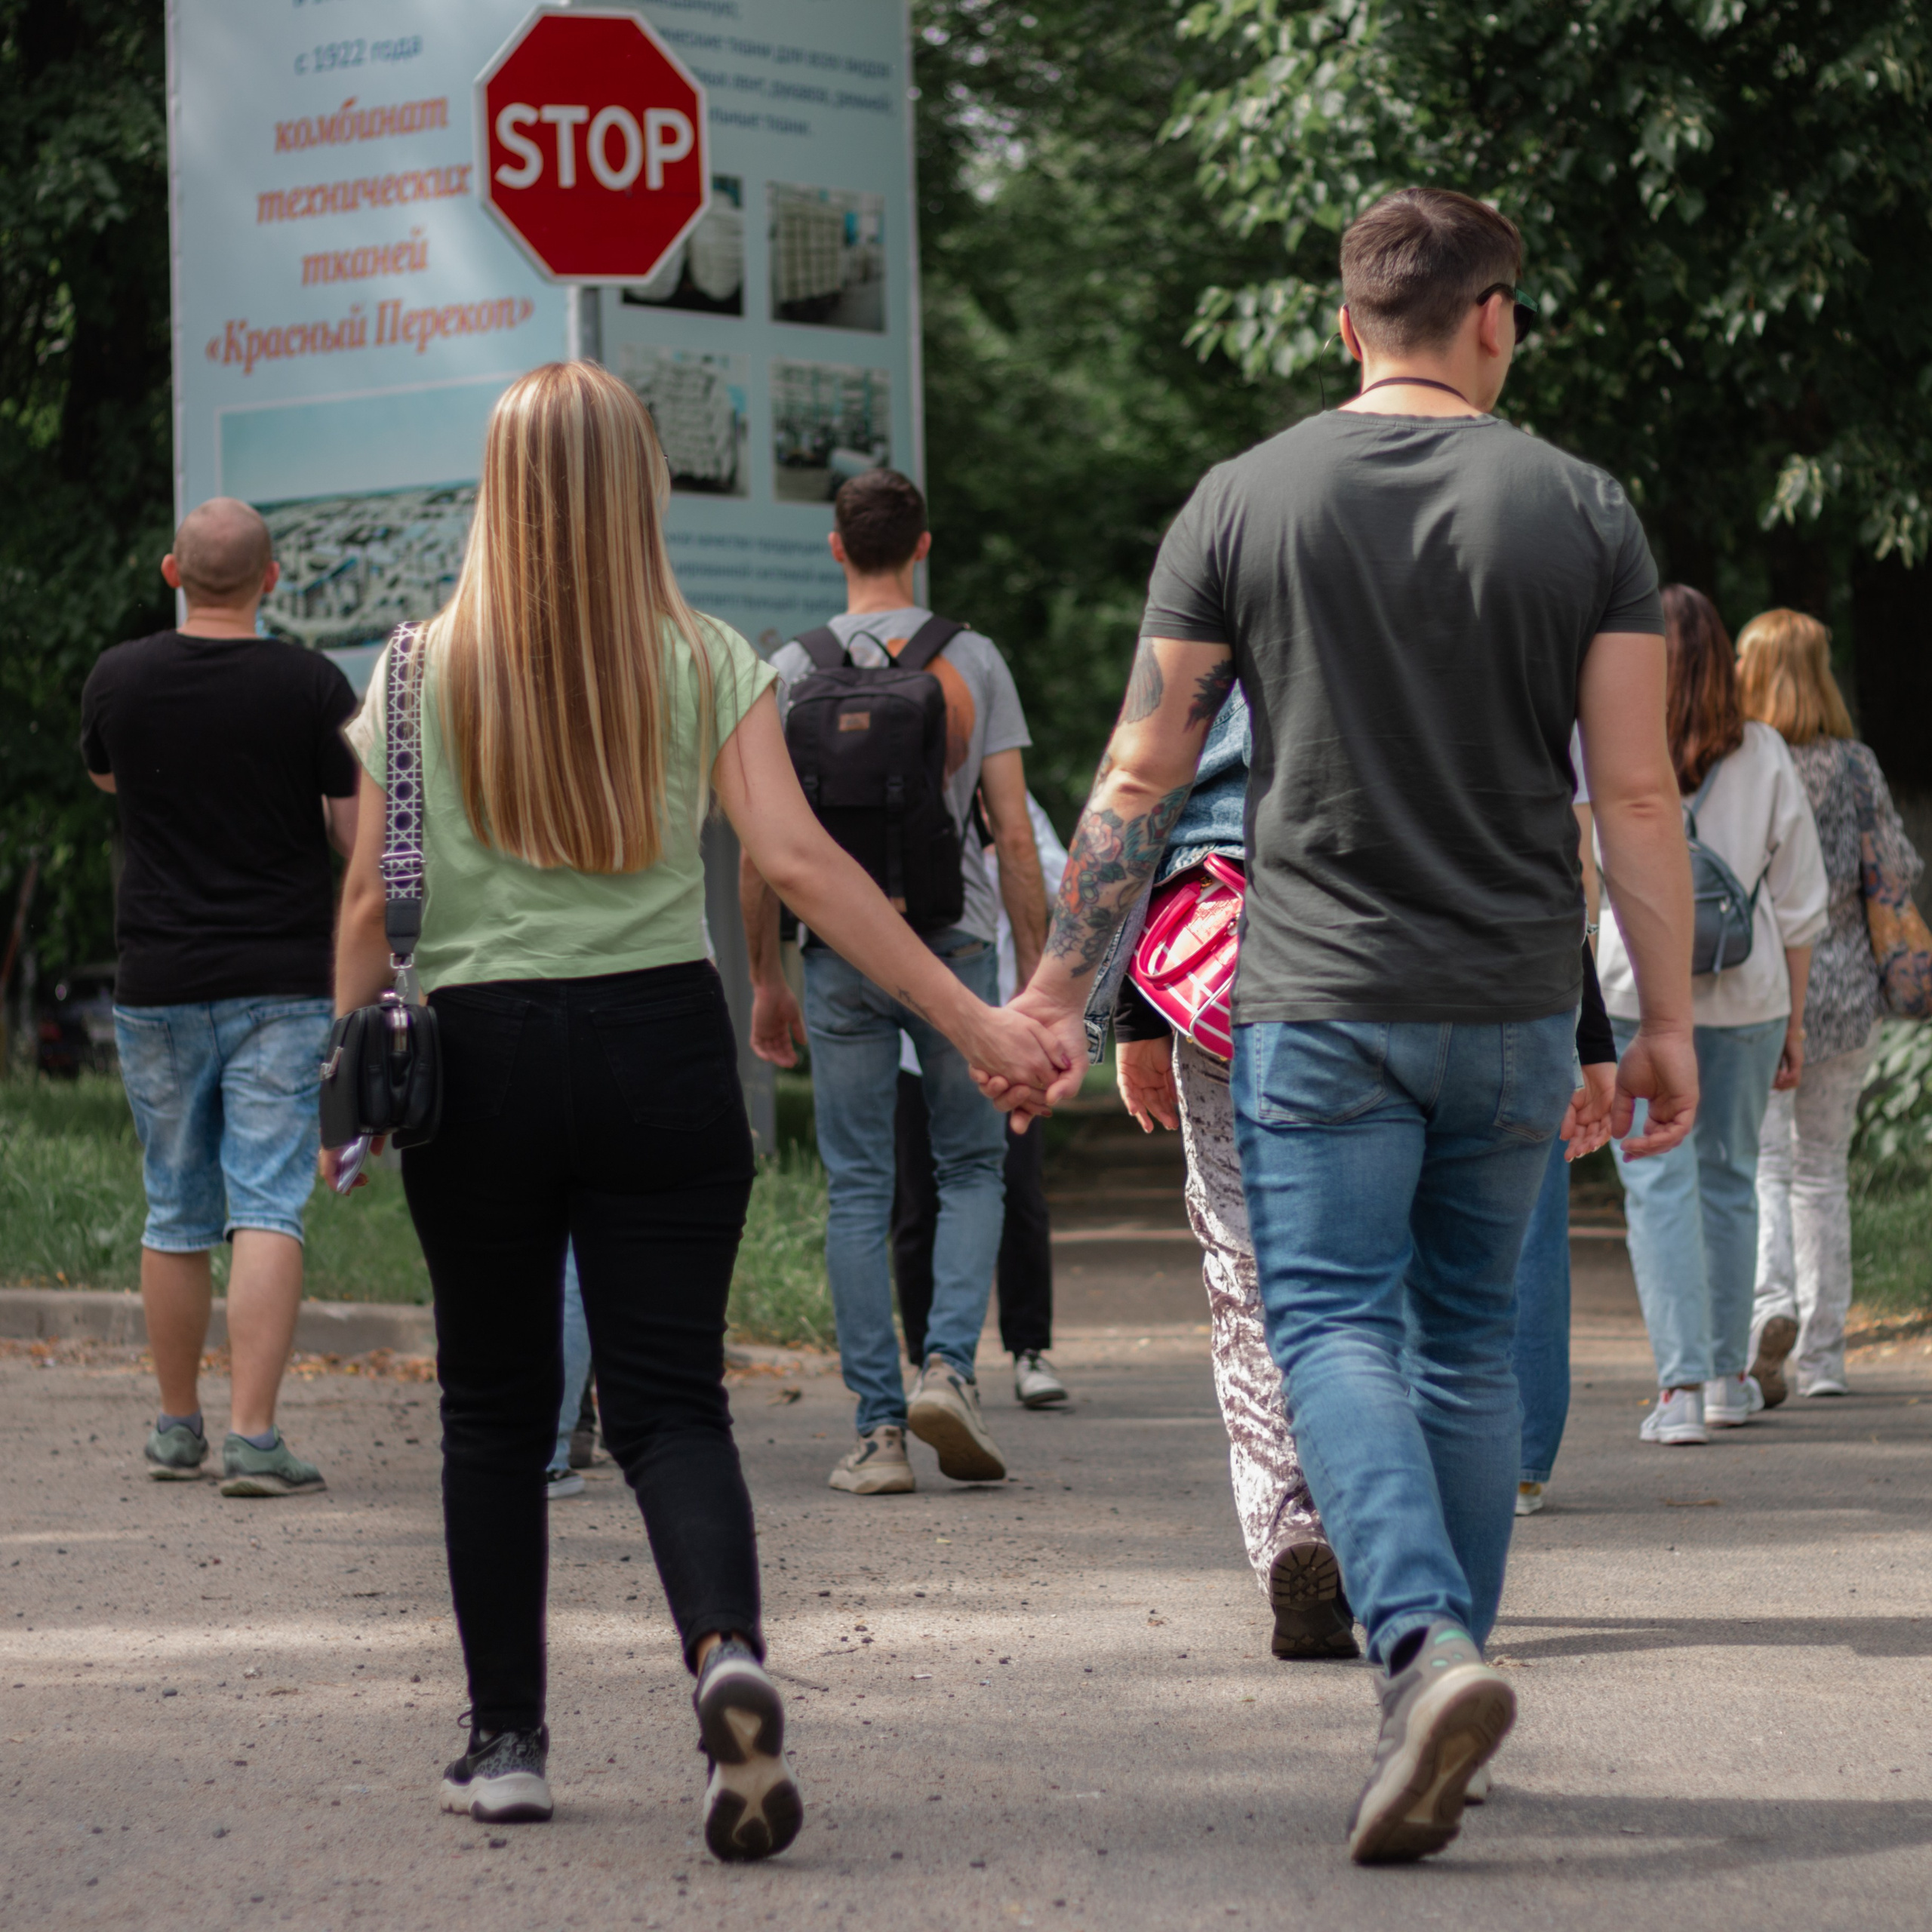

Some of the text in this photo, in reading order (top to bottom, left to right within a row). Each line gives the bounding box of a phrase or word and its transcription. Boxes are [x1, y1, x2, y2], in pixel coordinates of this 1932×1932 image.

[312, 38, 365, 73] 1922
[371, 35, 423, 66] года
[274, 95, 450, 154] комбинат
[494, 102, 696, 192] STOP
[257, 162, 473, 225] технических
[302, 227, 429, 288] тканей
[205, 296, 535, 376] «Красный Перекоп»
